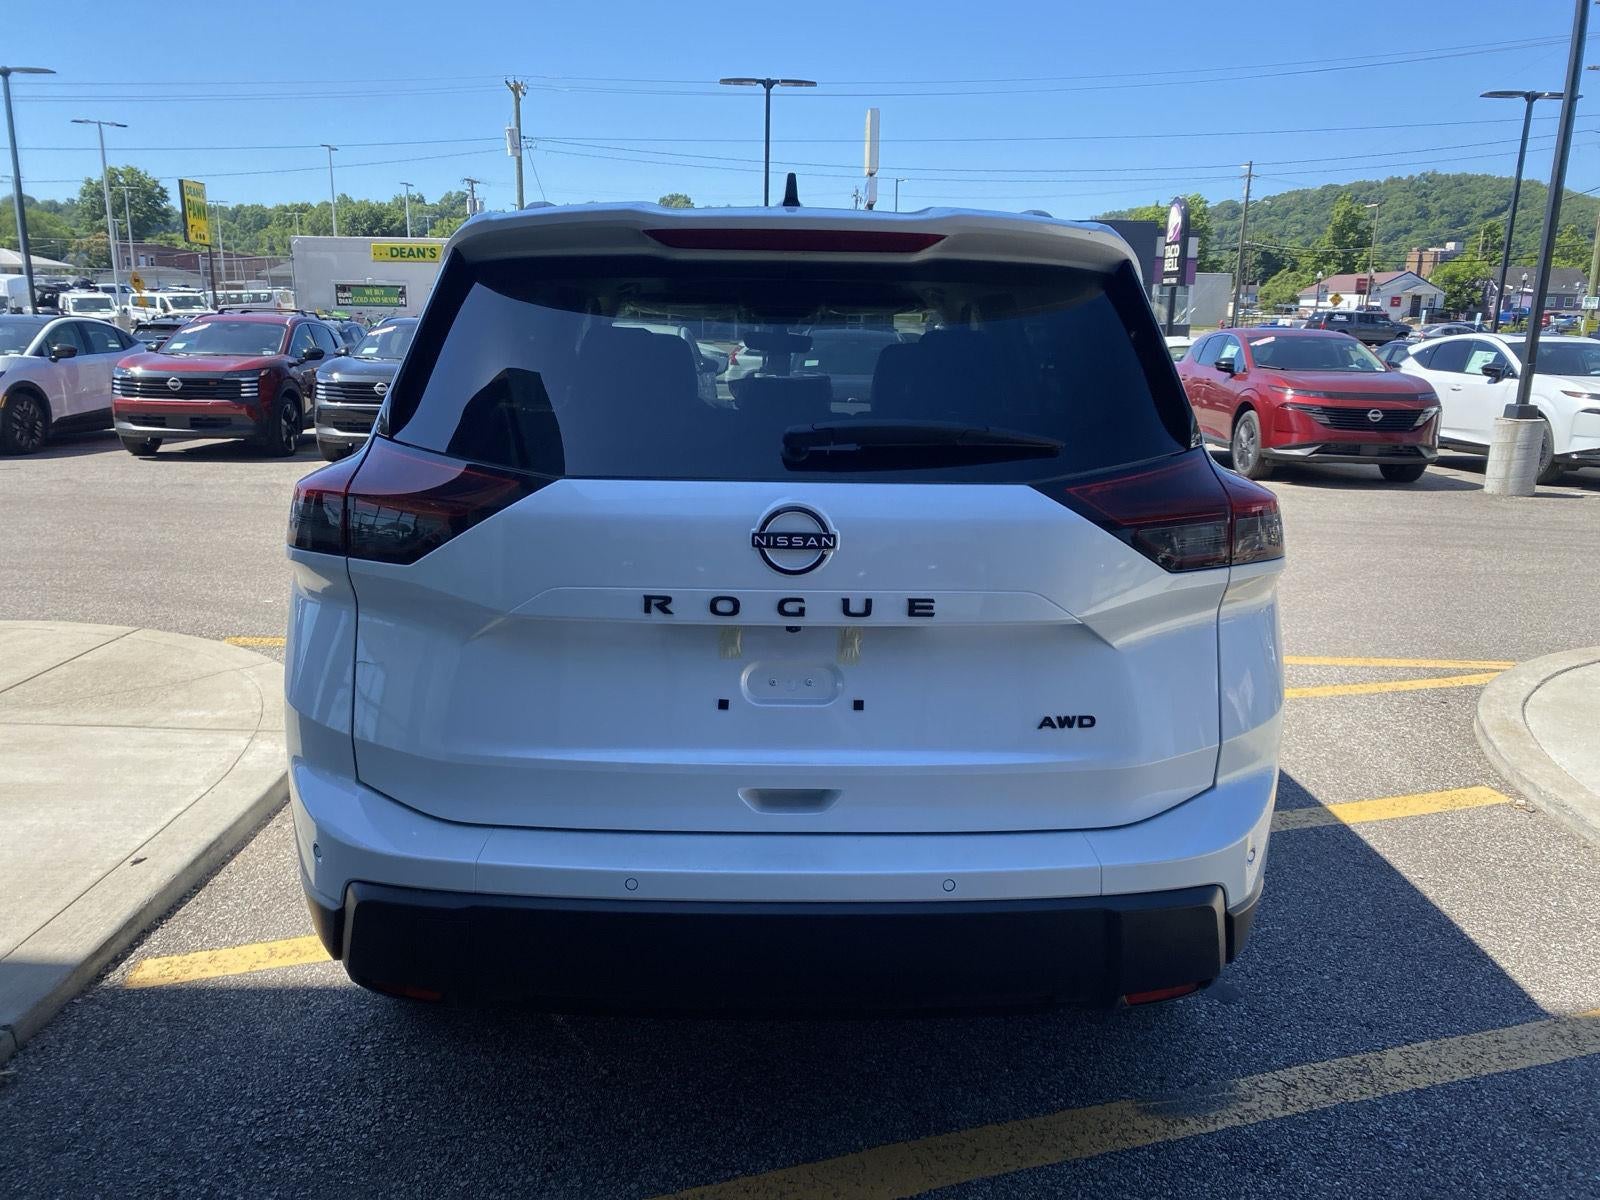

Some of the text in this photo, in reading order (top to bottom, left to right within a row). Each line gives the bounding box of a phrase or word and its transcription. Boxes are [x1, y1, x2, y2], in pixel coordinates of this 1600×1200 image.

[187, 199, 207, 221] PAWN
[1164, 244, 1180, 258] TACO
[1163, 258, 1179, 272] BELL
[364, 287, 373, 296] WE
[352, 296, 368, 304] GOLD
[754, 535, 834, 547] NISSAN
[643, 594, 936, 618] ROGUE
[1037, 715, 1096, 729] AWD
